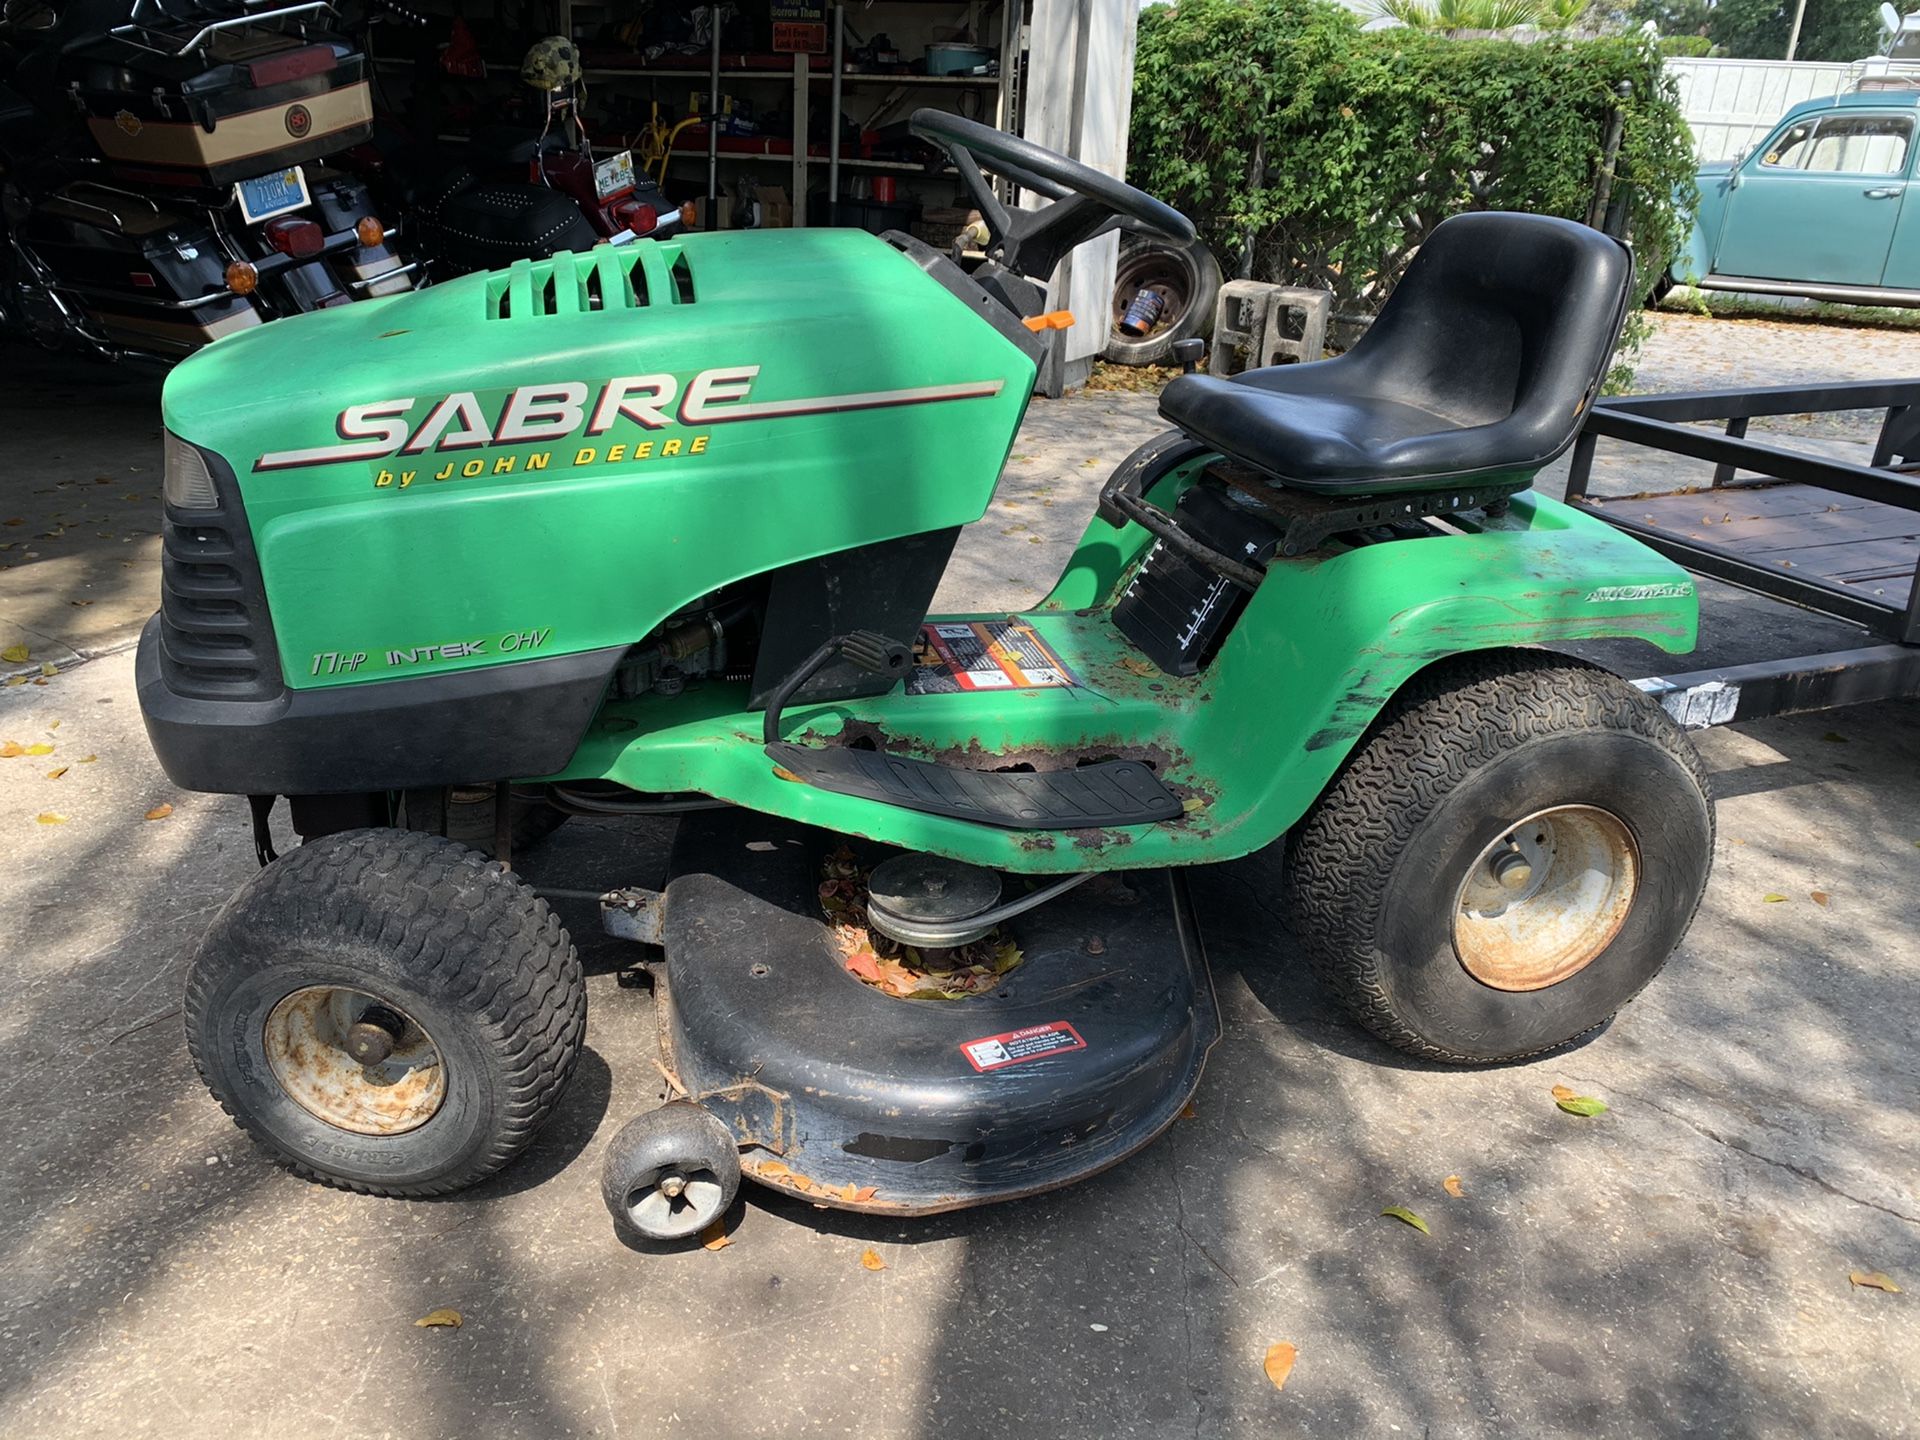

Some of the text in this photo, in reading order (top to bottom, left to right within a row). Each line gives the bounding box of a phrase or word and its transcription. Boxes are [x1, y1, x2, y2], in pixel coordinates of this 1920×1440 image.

[770, 6, 821, 18] Borrow Them
[336, 364, 761, 457] SABRE
[375, 434, 711, 489] by JOHN DEERE
[311, 627, 551, 676] 17HP INTEK OHV
